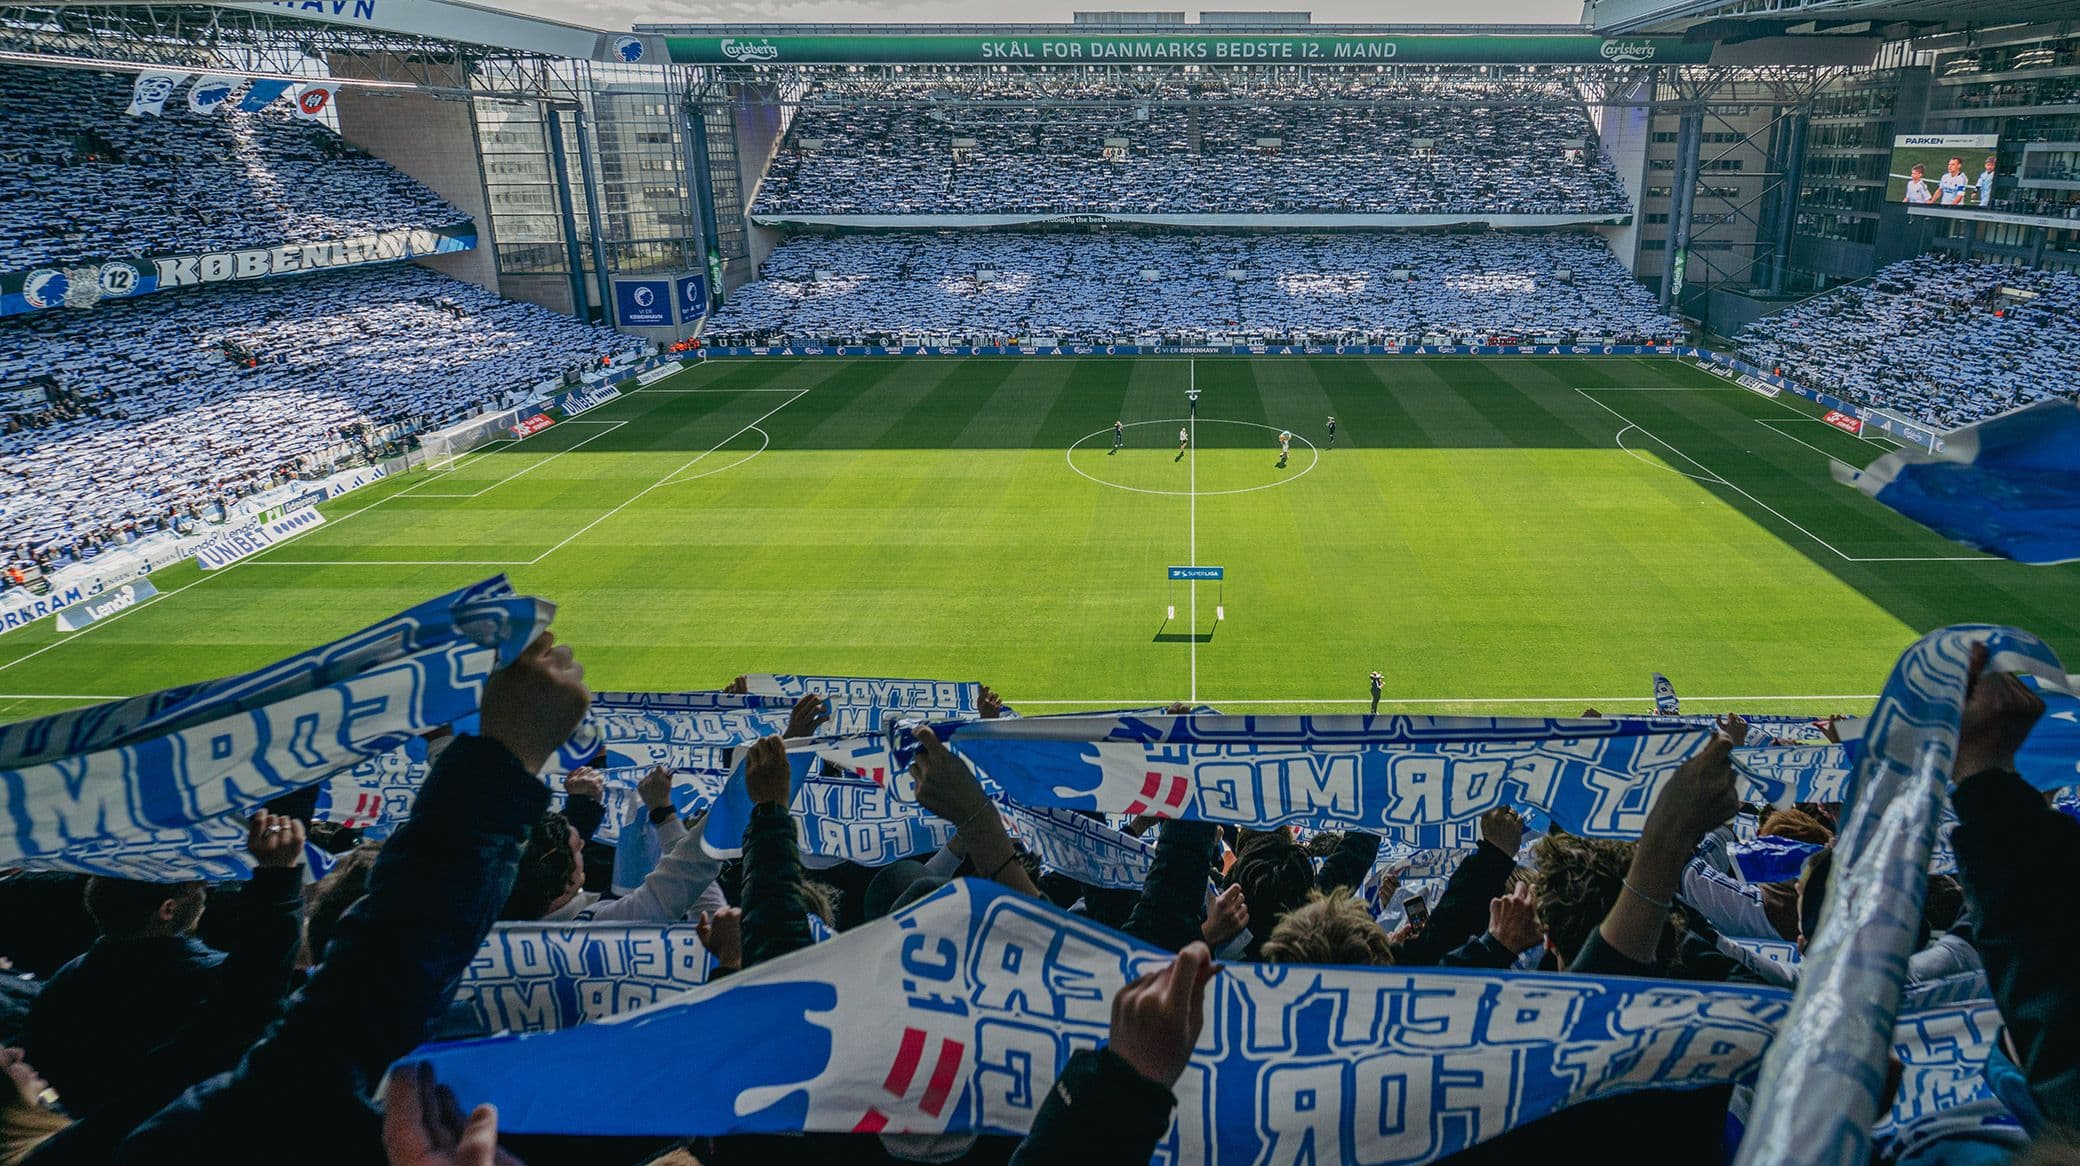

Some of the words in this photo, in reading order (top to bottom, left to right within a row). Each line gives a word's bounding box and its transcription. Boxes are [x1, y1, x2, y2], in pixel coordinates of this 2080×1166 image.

[721, 39, 778, 62] Carlsberg
[982, 41, 1034, 58] SKÅL
[1043, 42, 1082, 58] FOR
[1091, 42, 1207, 58] DANMARKS
[1216, 42, 1293, 58] BEDSTE
[1302, 43, 1325, 58] 12.
[1334, 42, 1397, 58] MAND
[1600, 40, 1656, 62] Carlsberg
[1905, 137, 1944, 145] PARKEN
[155, 231, 438, 290] KØBENHAVN
[108, 271, 129, 289] 12
[204, 526, 273, 565] UNIBET
[85, 586, 135, 619] Lendo
